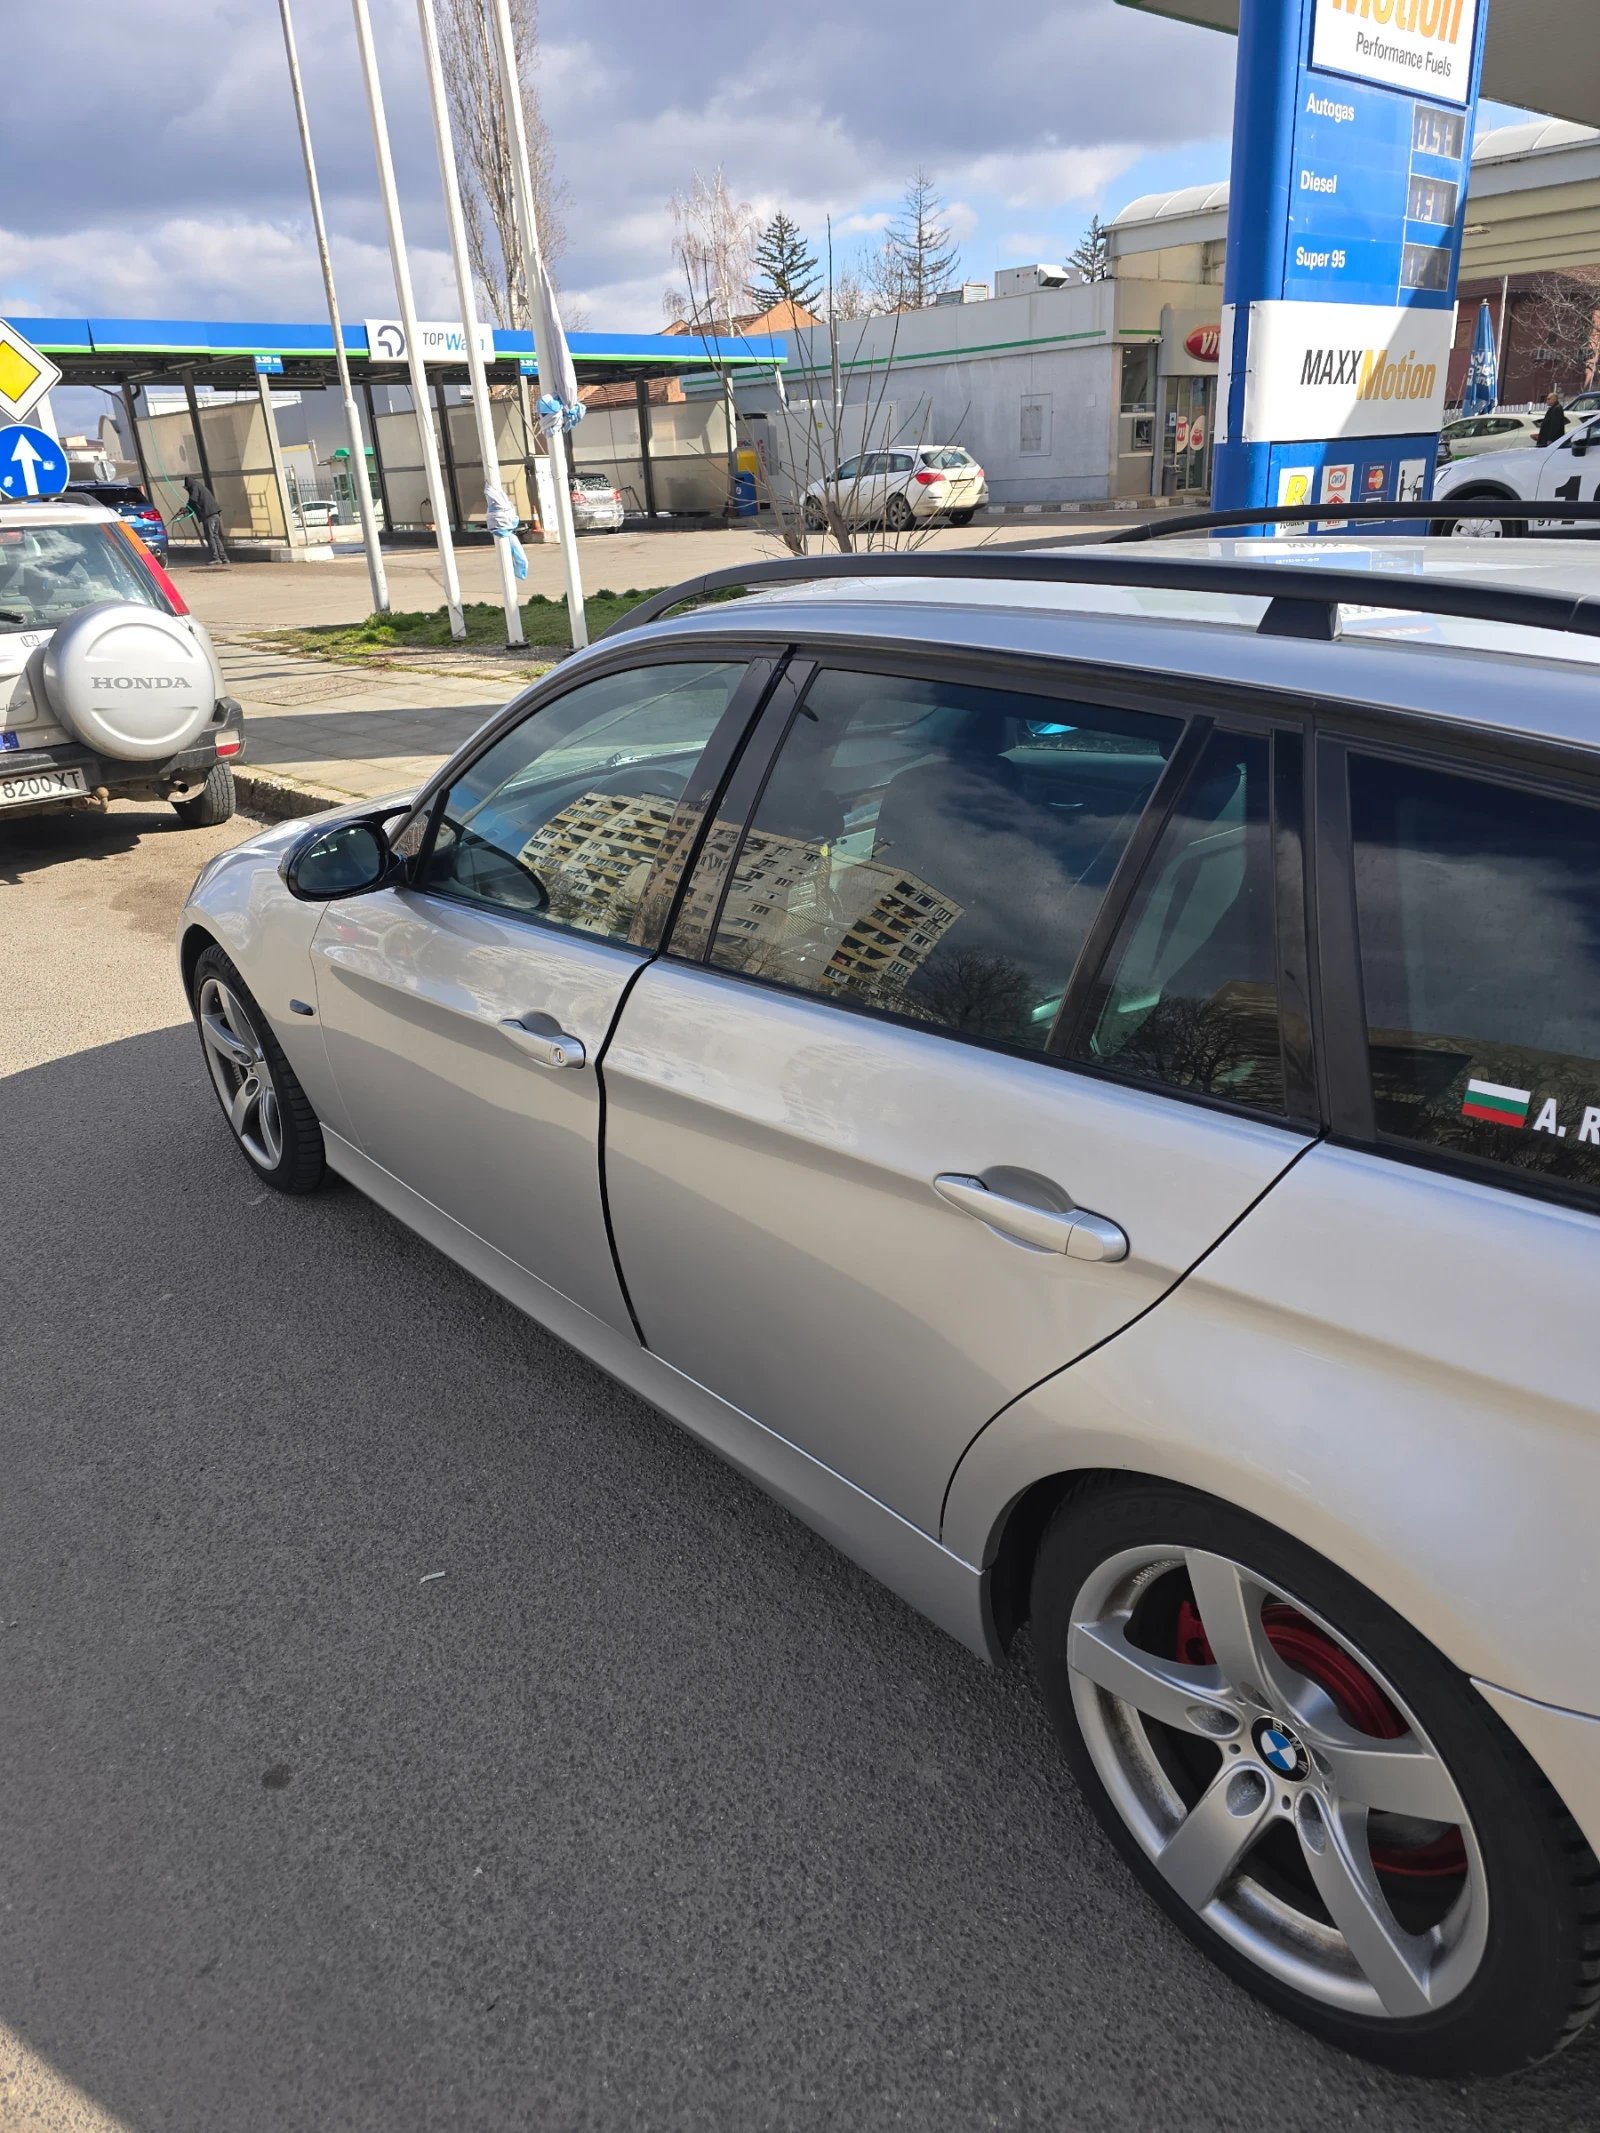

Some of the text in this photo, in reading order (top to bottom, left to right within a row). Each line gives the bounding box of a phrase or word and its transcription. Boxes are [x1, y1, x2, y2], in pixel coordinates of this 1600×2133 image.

[1356, 31, 1452, 78] Performance Fuels
[1305, 92, 1355, 123] Autogas
[1300, 169, 1337, 193] Diesel
[1296, 246, 1346, 270] Super 95
[91, 676, 192, 689] HONDA
[2, 770, 80, 799] 8200 XT
[1533, 1097, 1567, 1138] A.
[1272, 1719, 1309, 1774] BMW
